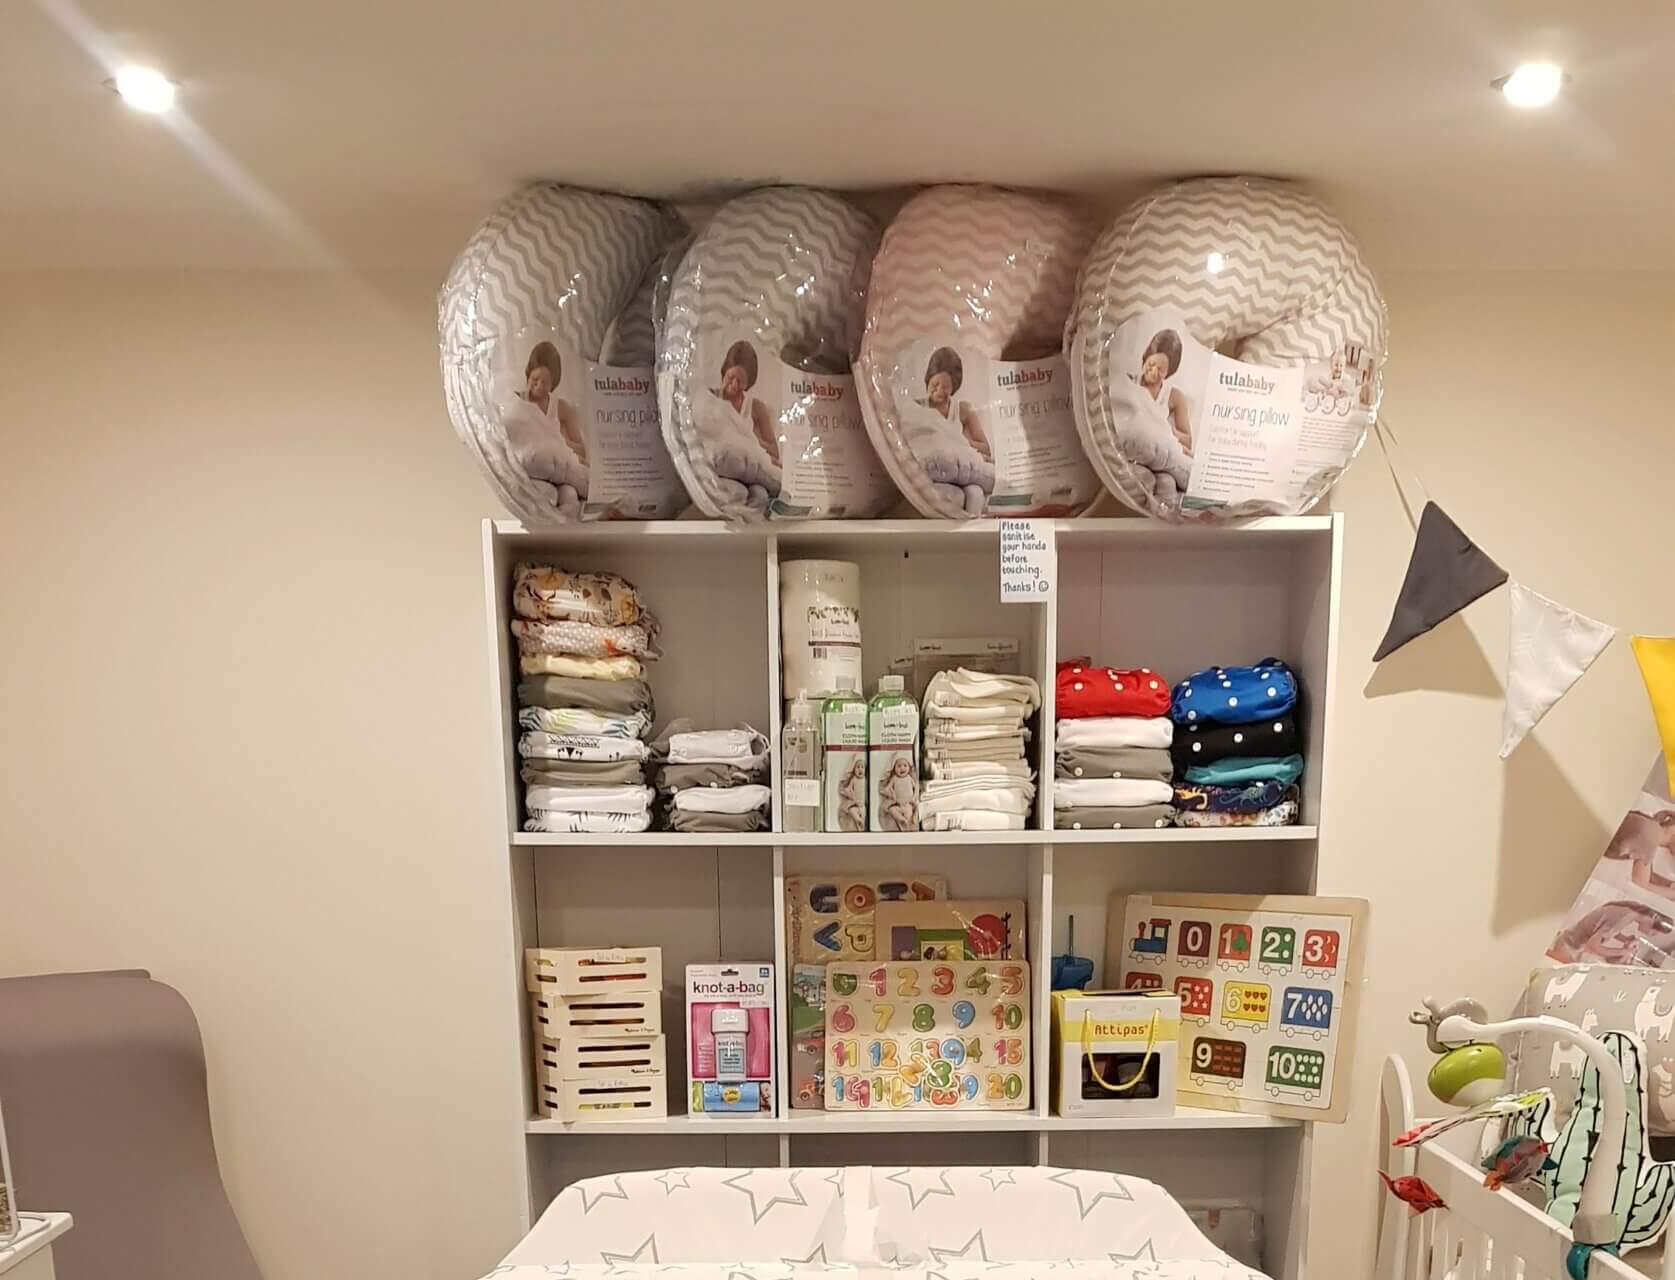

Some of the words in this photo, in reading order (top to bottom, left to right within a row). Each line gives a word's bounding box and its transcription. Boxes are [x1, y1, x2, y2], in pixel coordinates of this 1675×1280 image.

[594, 377, 650, 394] tulababy
[997, 368, 1053, 387] tulababy
[1219, 372, 1275, 394] tulababy
[791, 381, 844, 399] tulababy
[596, 409, 636, 428] nursing
[1212, 404, 1257, 427] nursing
[1259, 407, 1290, 428] pillow
[1002, 521, 1031, 530] Please
[1002, 531, 1036, 541] sanitise
[1002, 543, 1020, 553] your
[1022, 540, 1046, 551] hands
[1002, 553, 1028, 563] before
[1002, 564, 1042, 579] touching.
[1003, 580, 1036, 593] Thanks!
[1187, 926, 1203, 951] 0
[1221, 928, 1232, 955] 1
[1262, 932, 1281, 959] 2
[1305, 935, 1324, 962] 3
[693, 980, 765, 996] knot-a-bag
[869, 968, 887, 997] 1
[897, 967, 920, 997] 2
[931, 967, 955, 995] 3
[966, 967, 991, 995] 4
[1001, 966, 1023, 995] 5
[1178, 983, 1192, 1007] 5
[1225, 988, 1241, 1013] 6
[1287, 993, 1303, 1019] 7
[833, 1004, 855, 1032] 6
[872, 1004, 895, 1032] 7
[912, 1003, 935, 1032] 8
[952, 1000, 976, 1029] 9
[992, 1003, 1022, 1030] 10
[1095, 1024, 1145, 1037] Attipas
[832, 1041, 857, 1067] 11
[870, 1041, 899, 1067] 12
[994, 1038, 1022, 1065] 15
[1196, 1042, 1212, 1068] 9
[1269, 1052, 1296, 1079] 10
[987, 1072, 1022, 1099] 20
